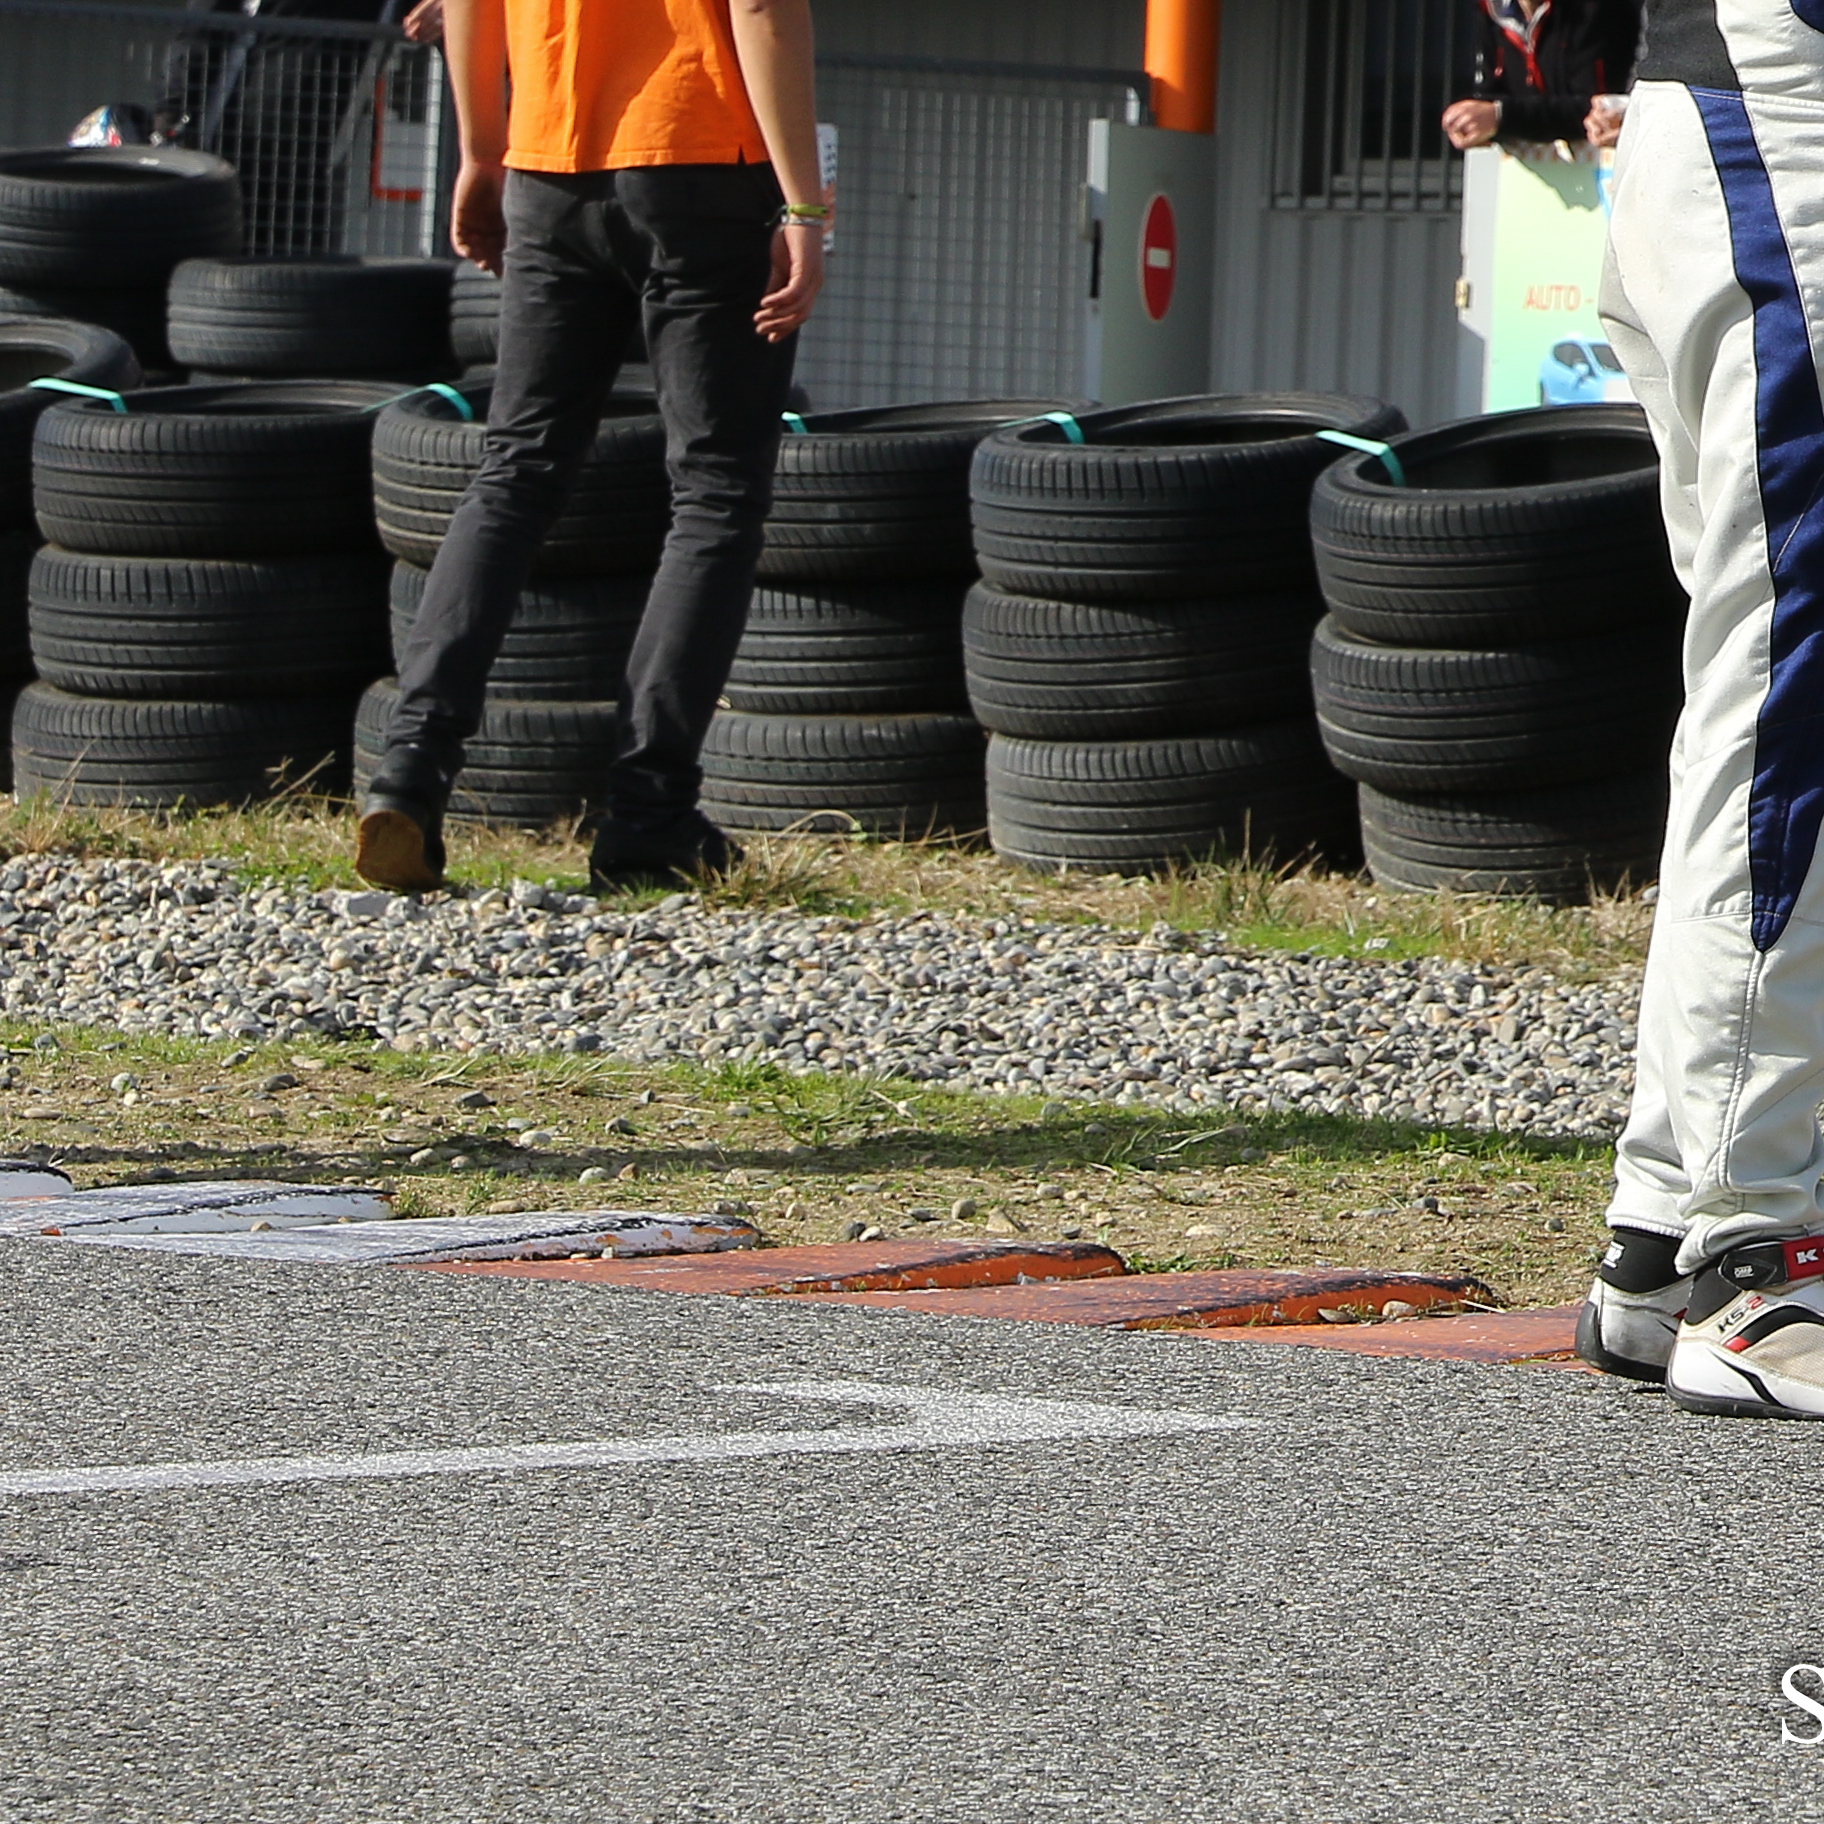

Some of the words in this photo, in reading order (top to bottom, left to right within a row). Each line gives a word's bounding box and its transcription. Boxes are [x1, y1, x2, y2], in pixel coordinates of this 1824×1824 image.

[1522, 284, 1580, 312] AUTO
[1796, 1247, 1819, 1265] K
[1716, 1294, 1766, 1335] KS-2
